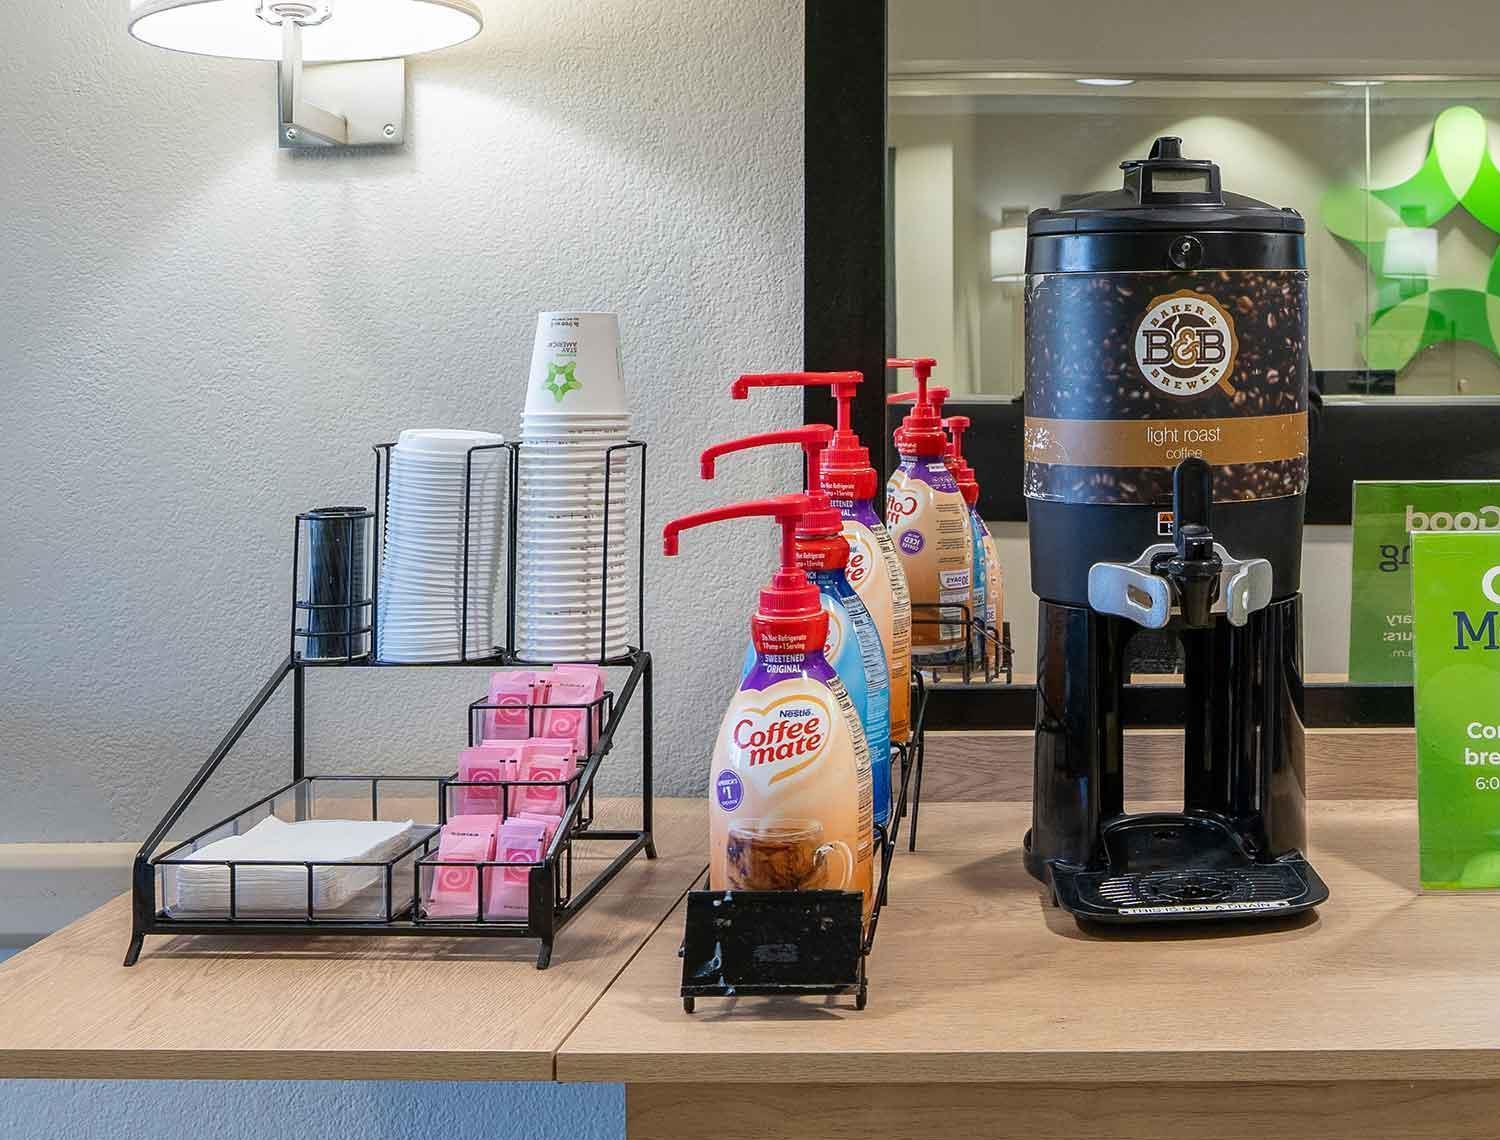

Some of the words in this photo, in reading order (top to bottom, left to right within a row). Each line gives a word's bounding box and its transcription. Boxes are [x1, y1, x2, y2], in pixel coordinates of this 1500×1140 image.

[1151, 304, 1204, 326] BAKER
[1142, 329, 1226, 366] B&B
[1151, 368, 1219, 390] BREWER
[1147, 427, 1178, 446] light
[1184, 428, 1220, 442] roast
[764, 654, 805, 662] SWEETENED
[766, 664, 802, 673] ORIGINAL
[734, 718, 820, 749] Coffee
[750, 734, 821, 766] mate
